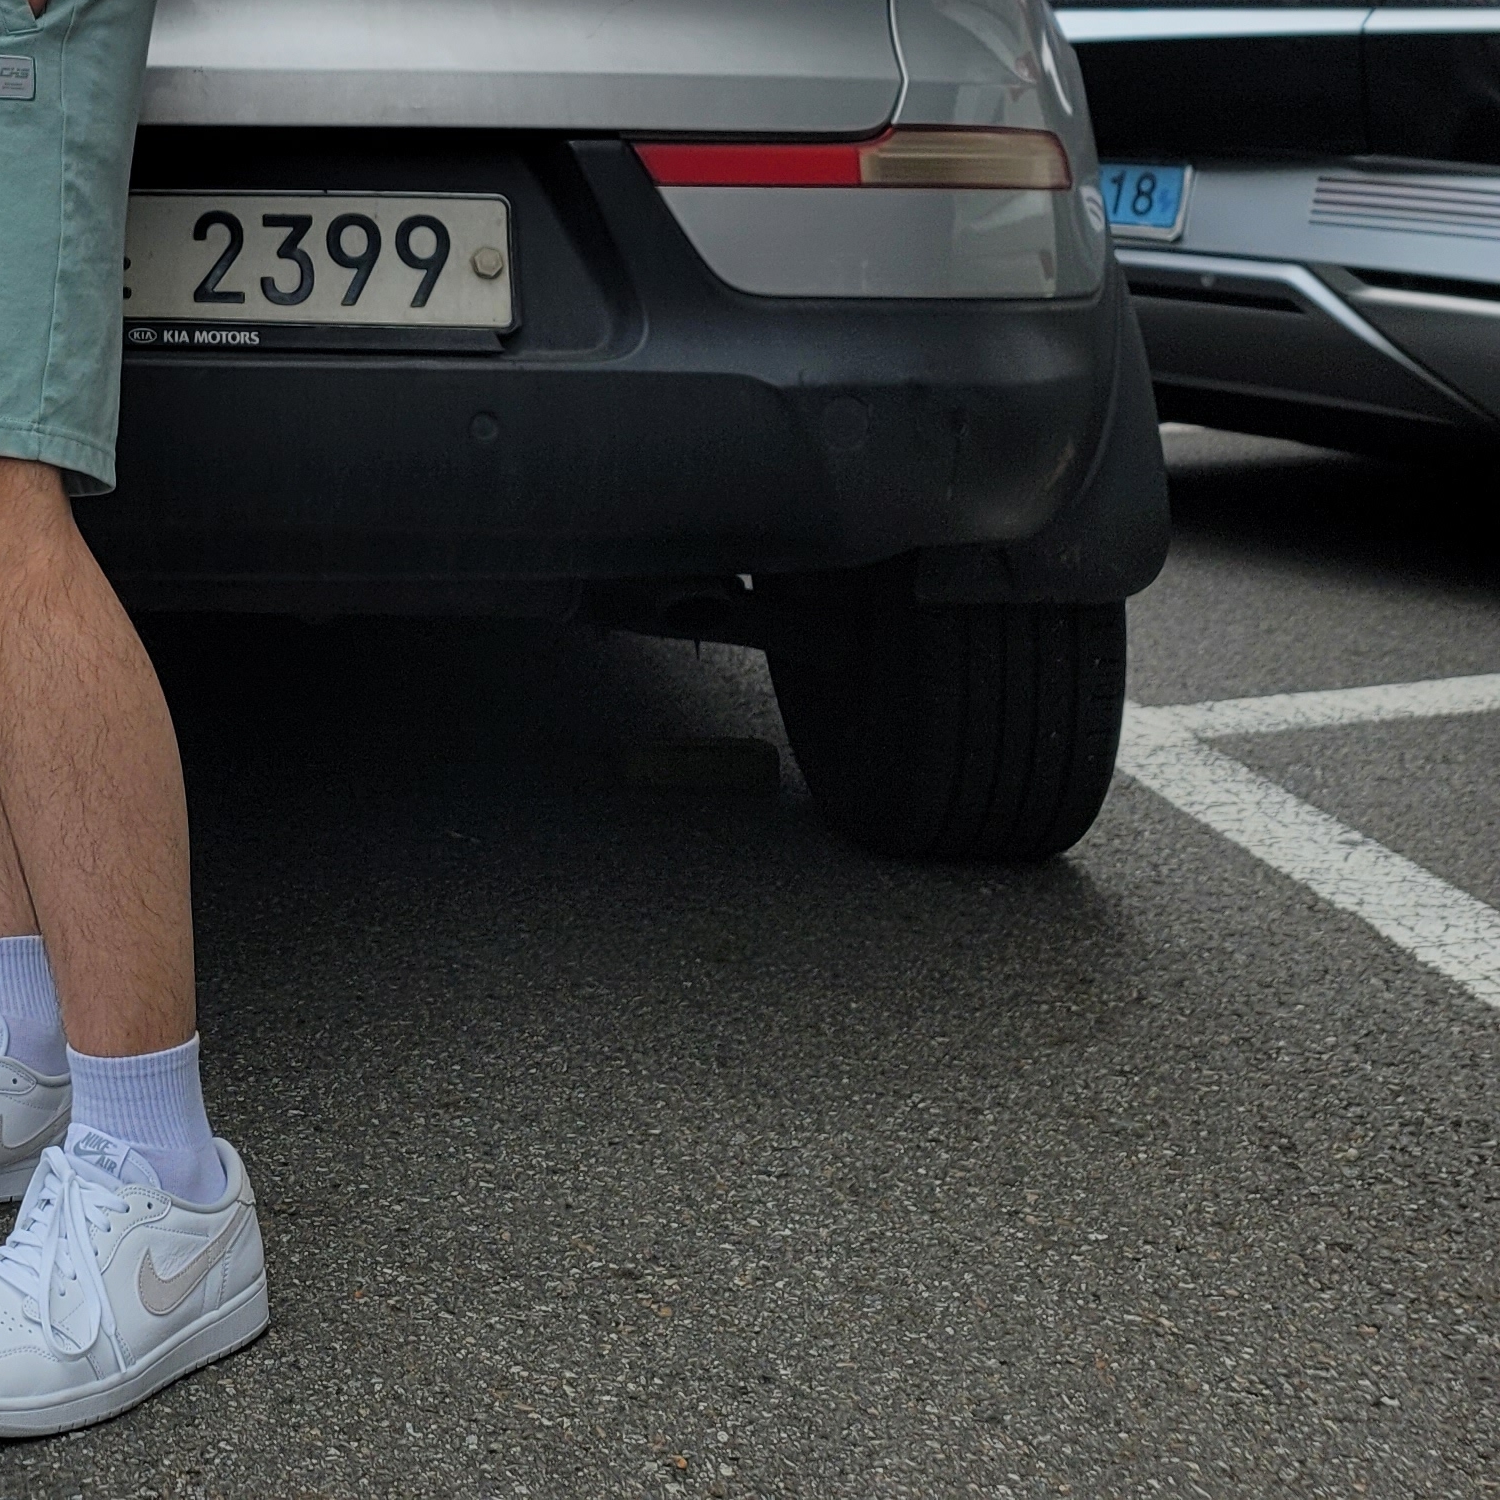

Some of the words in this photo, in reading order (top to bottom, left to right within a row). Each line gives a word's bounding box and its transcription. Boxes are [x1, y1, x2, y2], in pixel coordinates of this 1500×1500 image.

[1110, 170, 1157, 216] 18
[193, 209, 451, 309] 2399
[163, 330, 190, 343] KIA
[193, 330, 260, 345] MOTORS
[80, 1131, 114, 1152] NIKE
[94, 1154, 118, 1174] AIR
